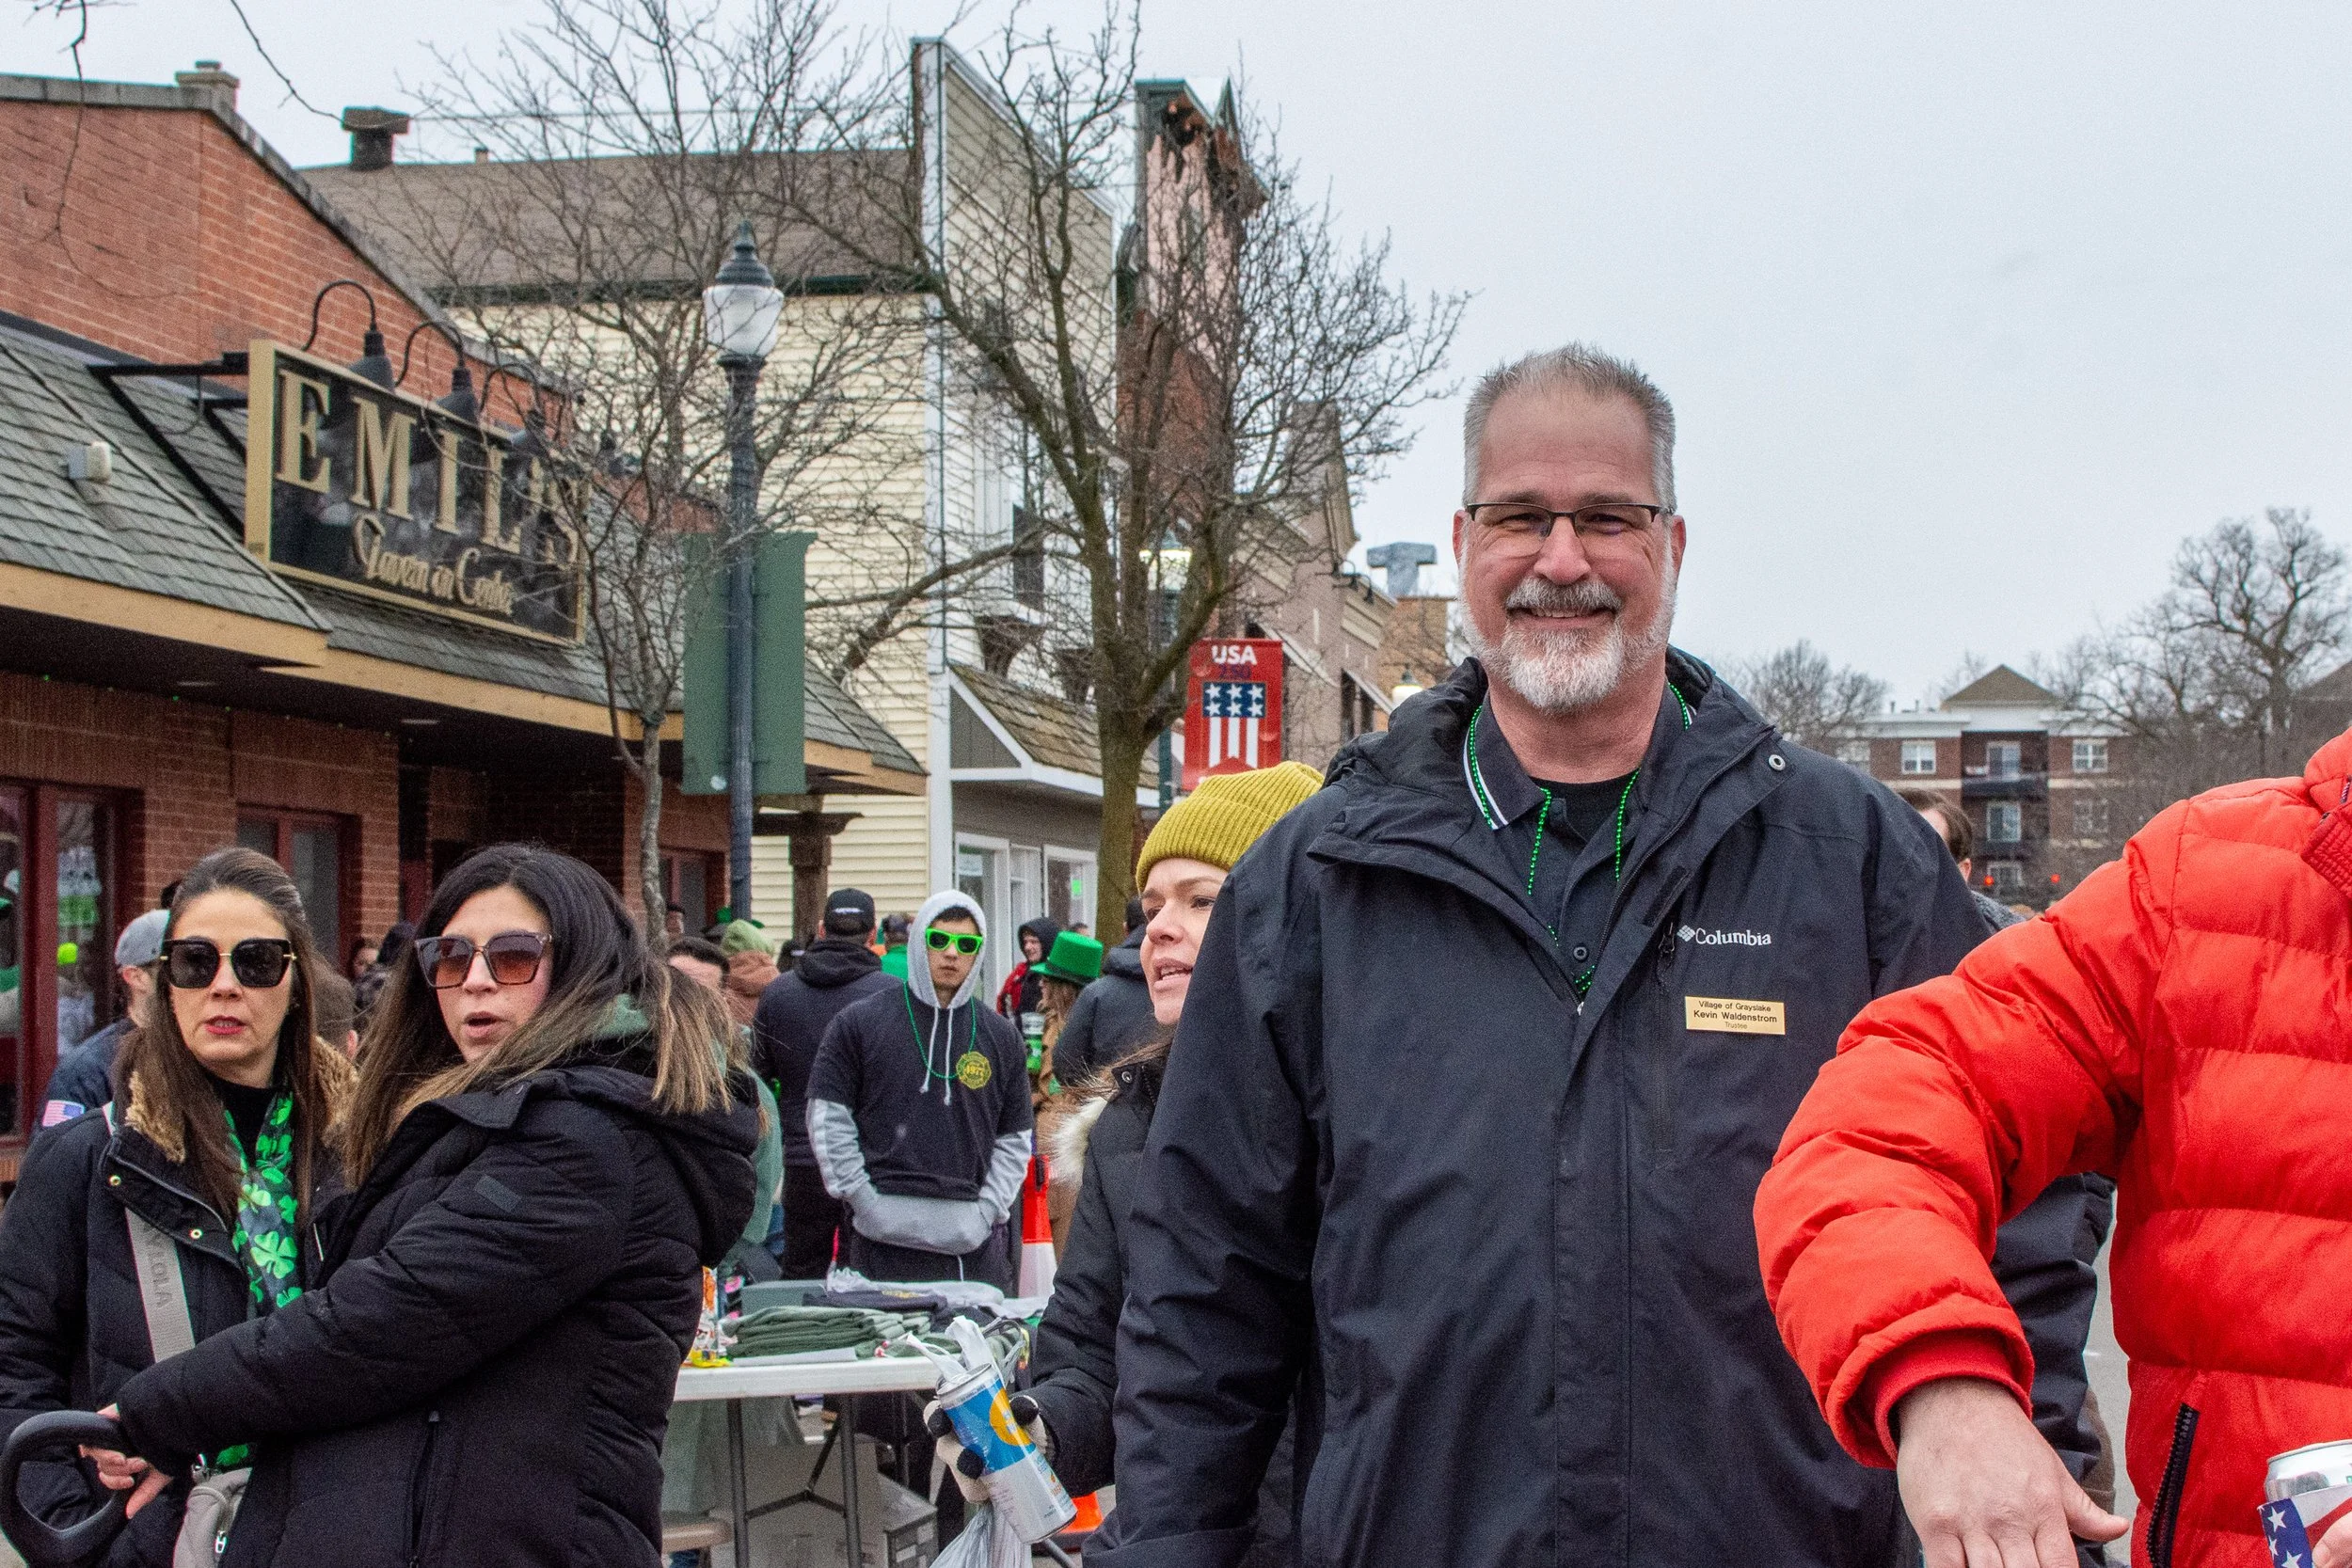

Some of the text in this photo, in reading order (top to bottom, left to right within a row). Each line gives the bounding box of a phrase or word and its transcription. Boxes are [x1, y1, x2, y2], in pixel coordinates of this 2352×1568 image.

[354, 513, 430, 594] Tavern
[1212, 645, 1258, 665] USA
[1696, 927, 1772, 946] Columbia
[1693, 1010, 1777, 1022] Kevin Waldenstrom
[1699, 1001, 1723, 1009] Village
[1736, 1003, 1772, 1012] Grayslake
